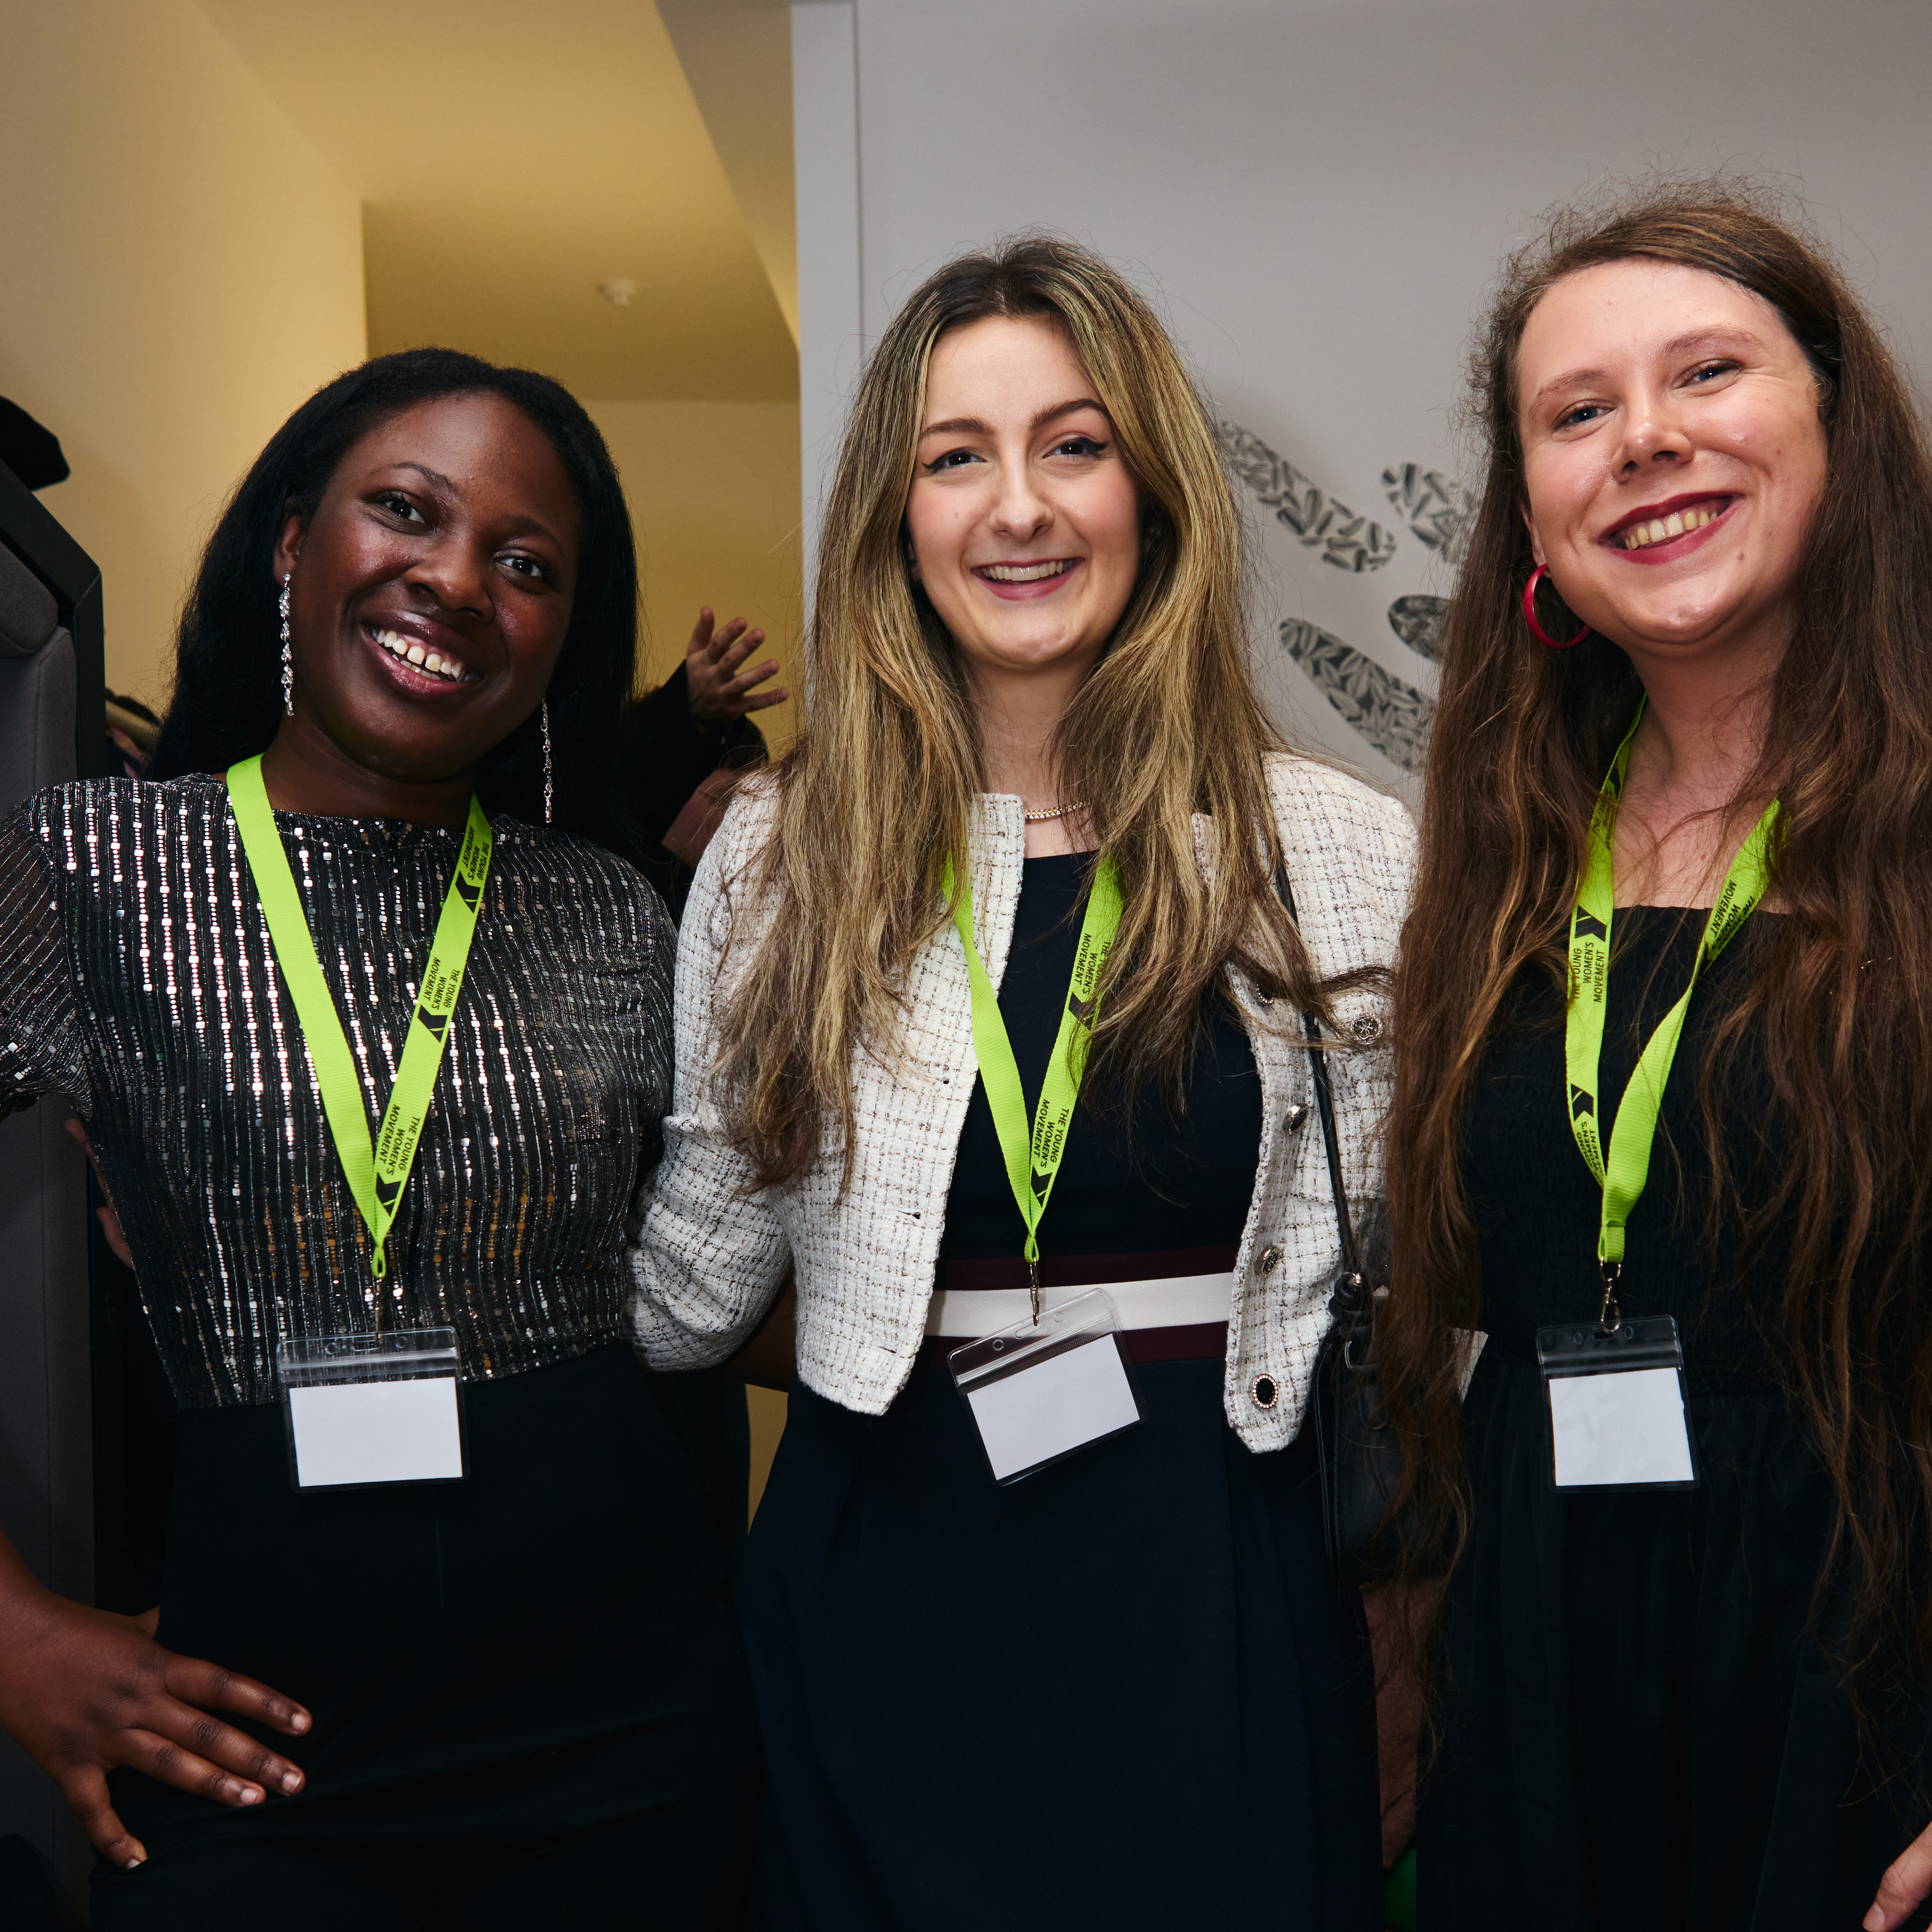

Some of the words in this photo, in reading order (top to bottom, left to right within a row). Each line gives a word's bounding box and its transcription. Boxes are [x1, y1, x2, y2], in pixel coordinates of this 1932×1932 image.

[462, 826, 474, 868] MOVEMENT
[468, 845, 480, 880] WOMEN'S
[477, 855, 487, 880] YOUNG
[1711, 880, 1737, 937] MOVEMENT
[1743, 896, 1755, 916] THE
[423, 956, 441, 1001] MOVEMENT
[450, 969, 460, 983] THE
[1075, 933, 1092, 985] MOVEMENT
[1082, 953, 1098, 995] WOMEN'S
[1583, 942, 1594, 983] WOMEN'S
[1594, 949, 1605, 1003] MOVEMENT
[431, 976, 447, 1010] WOMEN'S
[443, 983, 456, 1008] YOUNG
[379, 1104, 400, 1164] MOVEMENT
[409, 1117, 420, 1135] THE
[1034, 1099, 1050, 1158] MOVEMENT
[1058, 1108, 1069, 1127] THE
[386, 1129, 405, 1175] WOMEN'S
[398, 1137, 414, 1171] YOUNG
[1041, 1122, 1055, 1168] WOMEN'S
[1050, 1129, 1064, 1163] YOUNG
[1581, 1121, 1598, 1170] WOMEN'S
